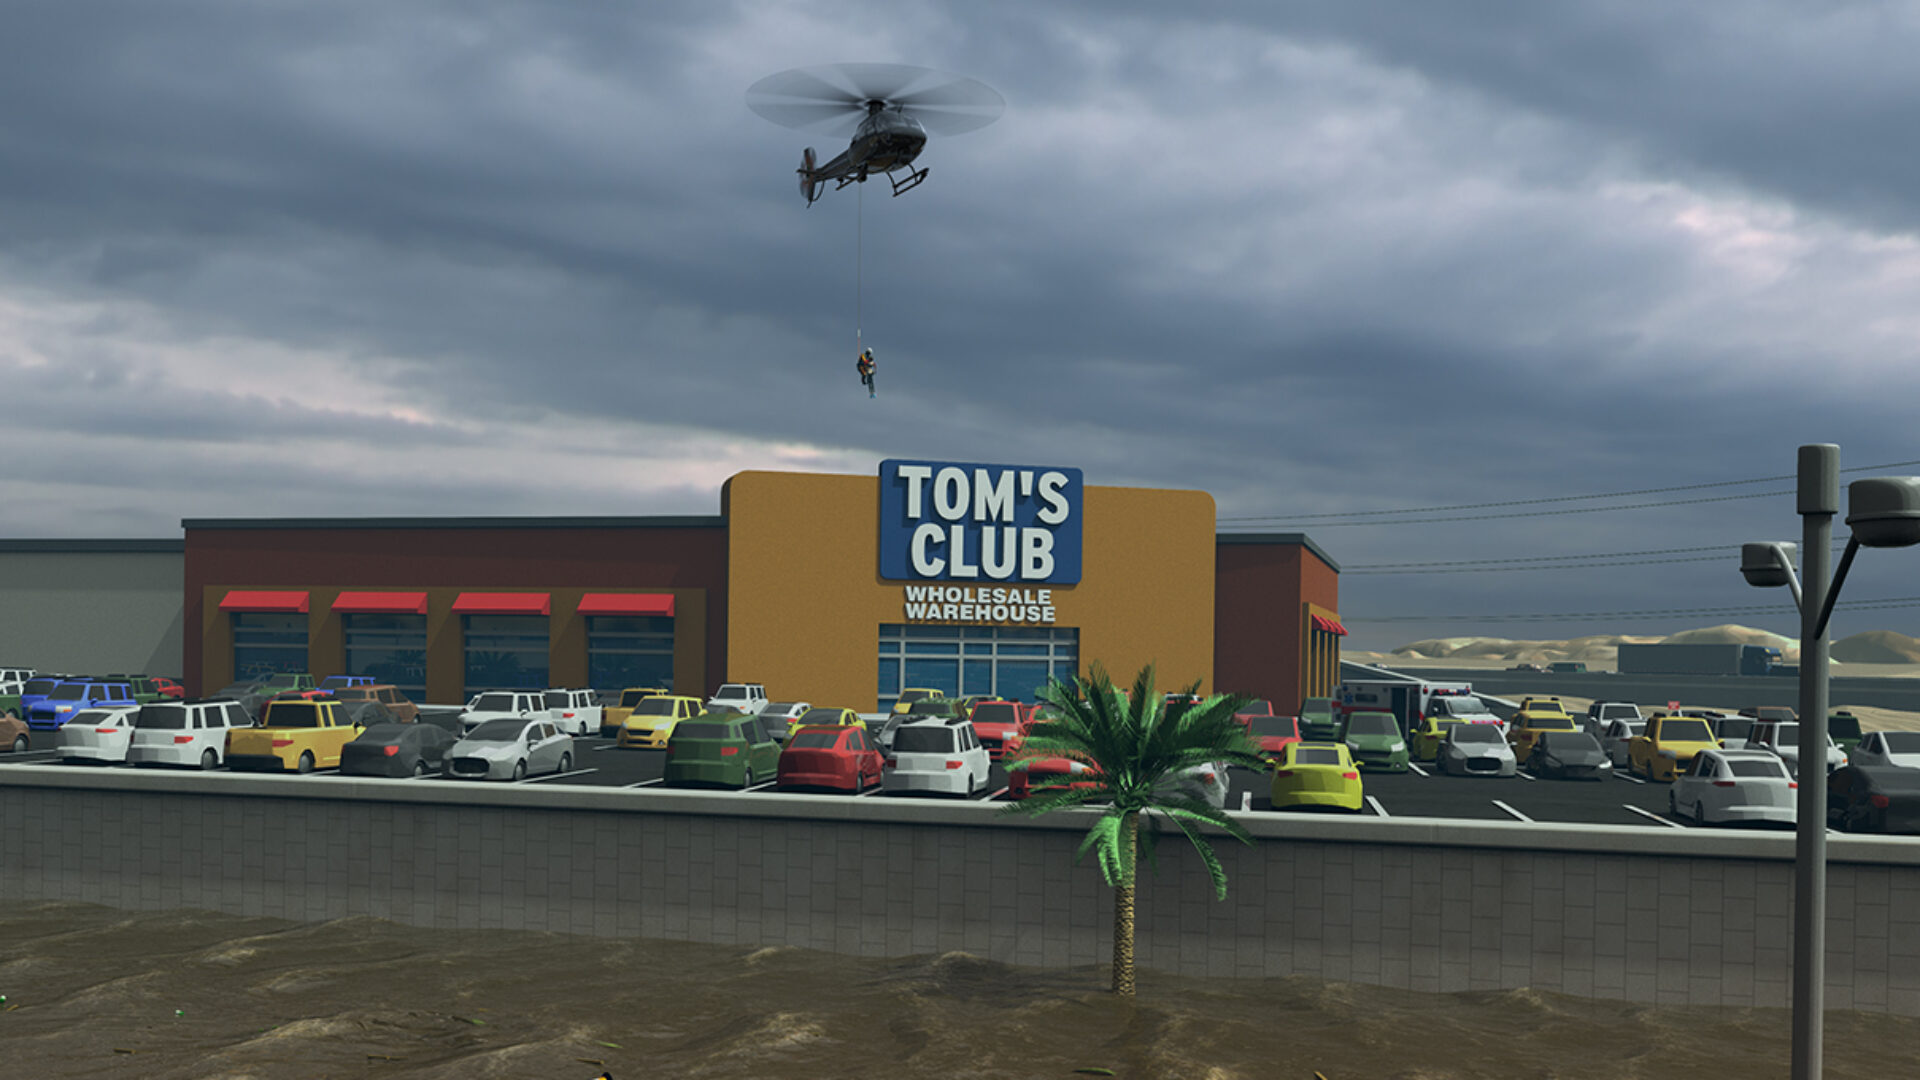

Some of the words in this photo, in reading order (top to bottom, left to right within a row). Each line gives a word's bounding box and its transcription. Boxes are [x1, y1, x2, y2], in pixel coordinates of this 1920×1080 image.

[898, 465, 1070, 525] TOM'S
[911, 523, 1054, 580] CLUB
[905, 585, 1052, 606] WHOLESALE
[905, 603, 1056, 623] WAREHOUSE
